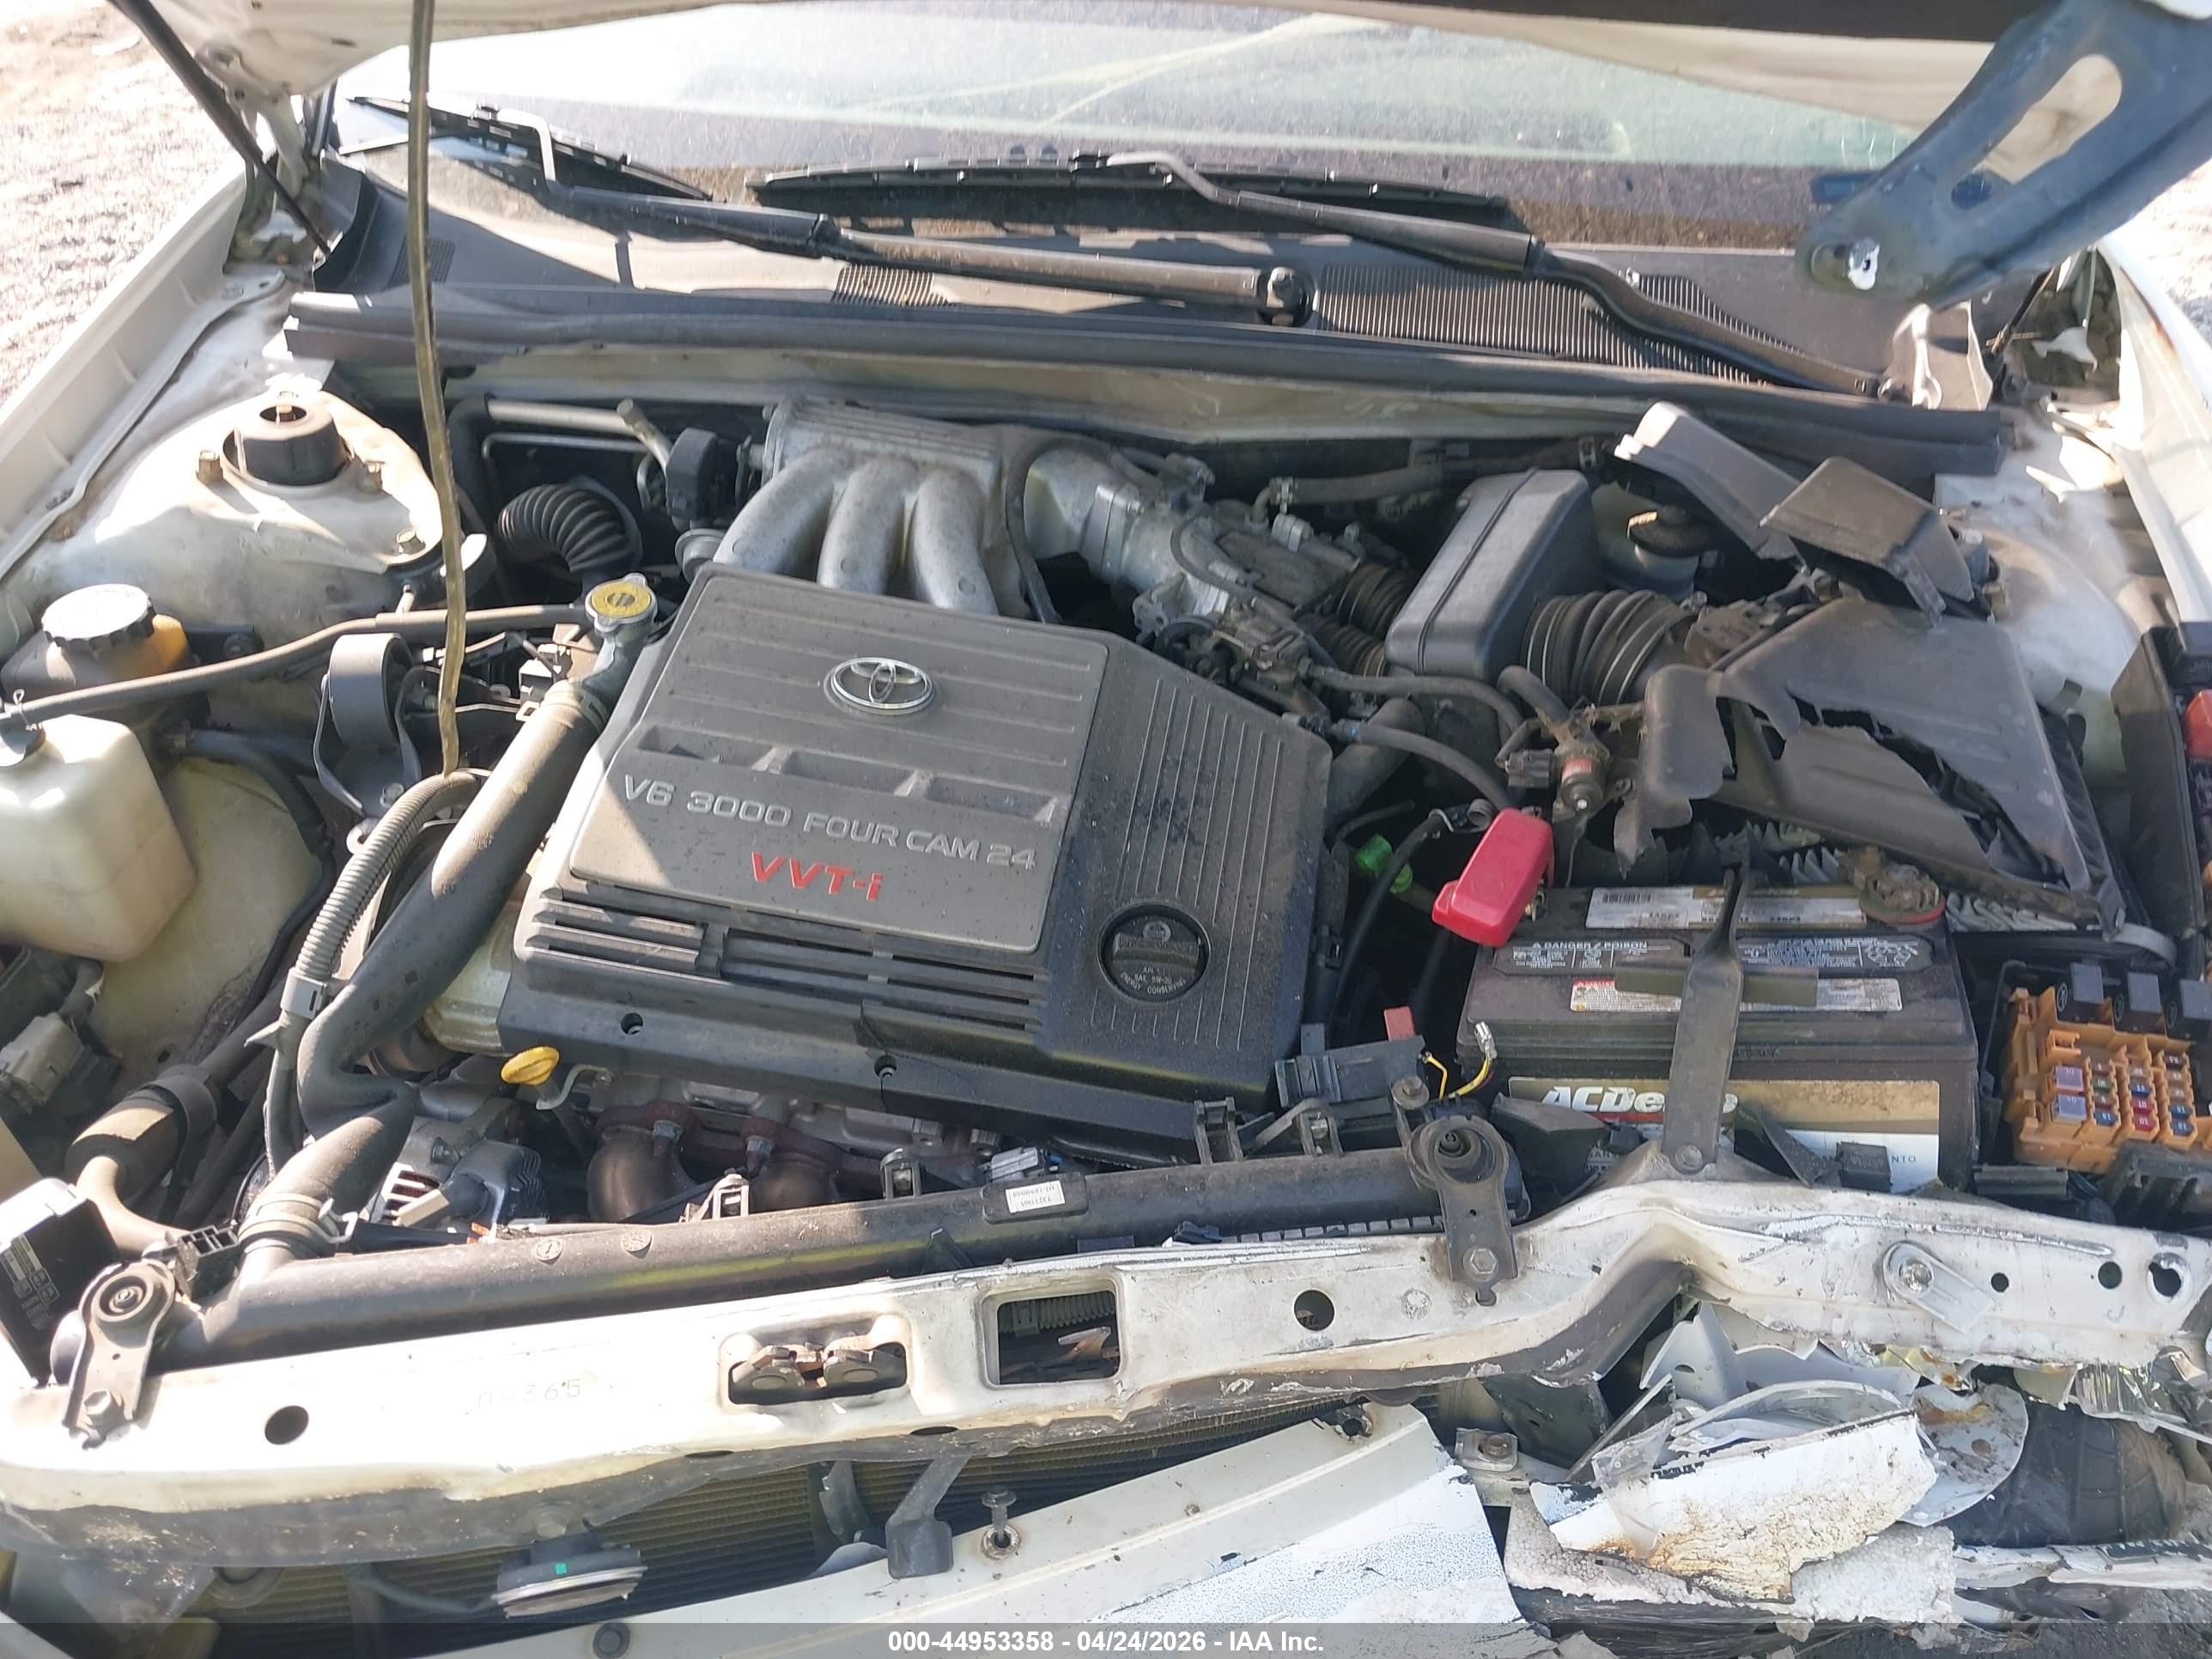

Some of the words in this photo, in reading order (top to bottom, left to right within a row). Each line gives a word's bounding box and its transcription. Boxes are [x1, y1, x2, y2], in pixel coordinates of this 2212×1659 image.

[624, 774, 676, 807] V6
[686, 790, 793, 828] 3000
[803, 811, 901, 848] FOUR
[906, 830, 981, 861] CAM
[986, 843, 1037, 872] 24
[751, 851, 884, 902] VVT-i
[1544, 941, 1591, 950] DANGER
[1603, 940, 1649, 949] POISON
[1541, 1085, 1739, 1114] ACDe
